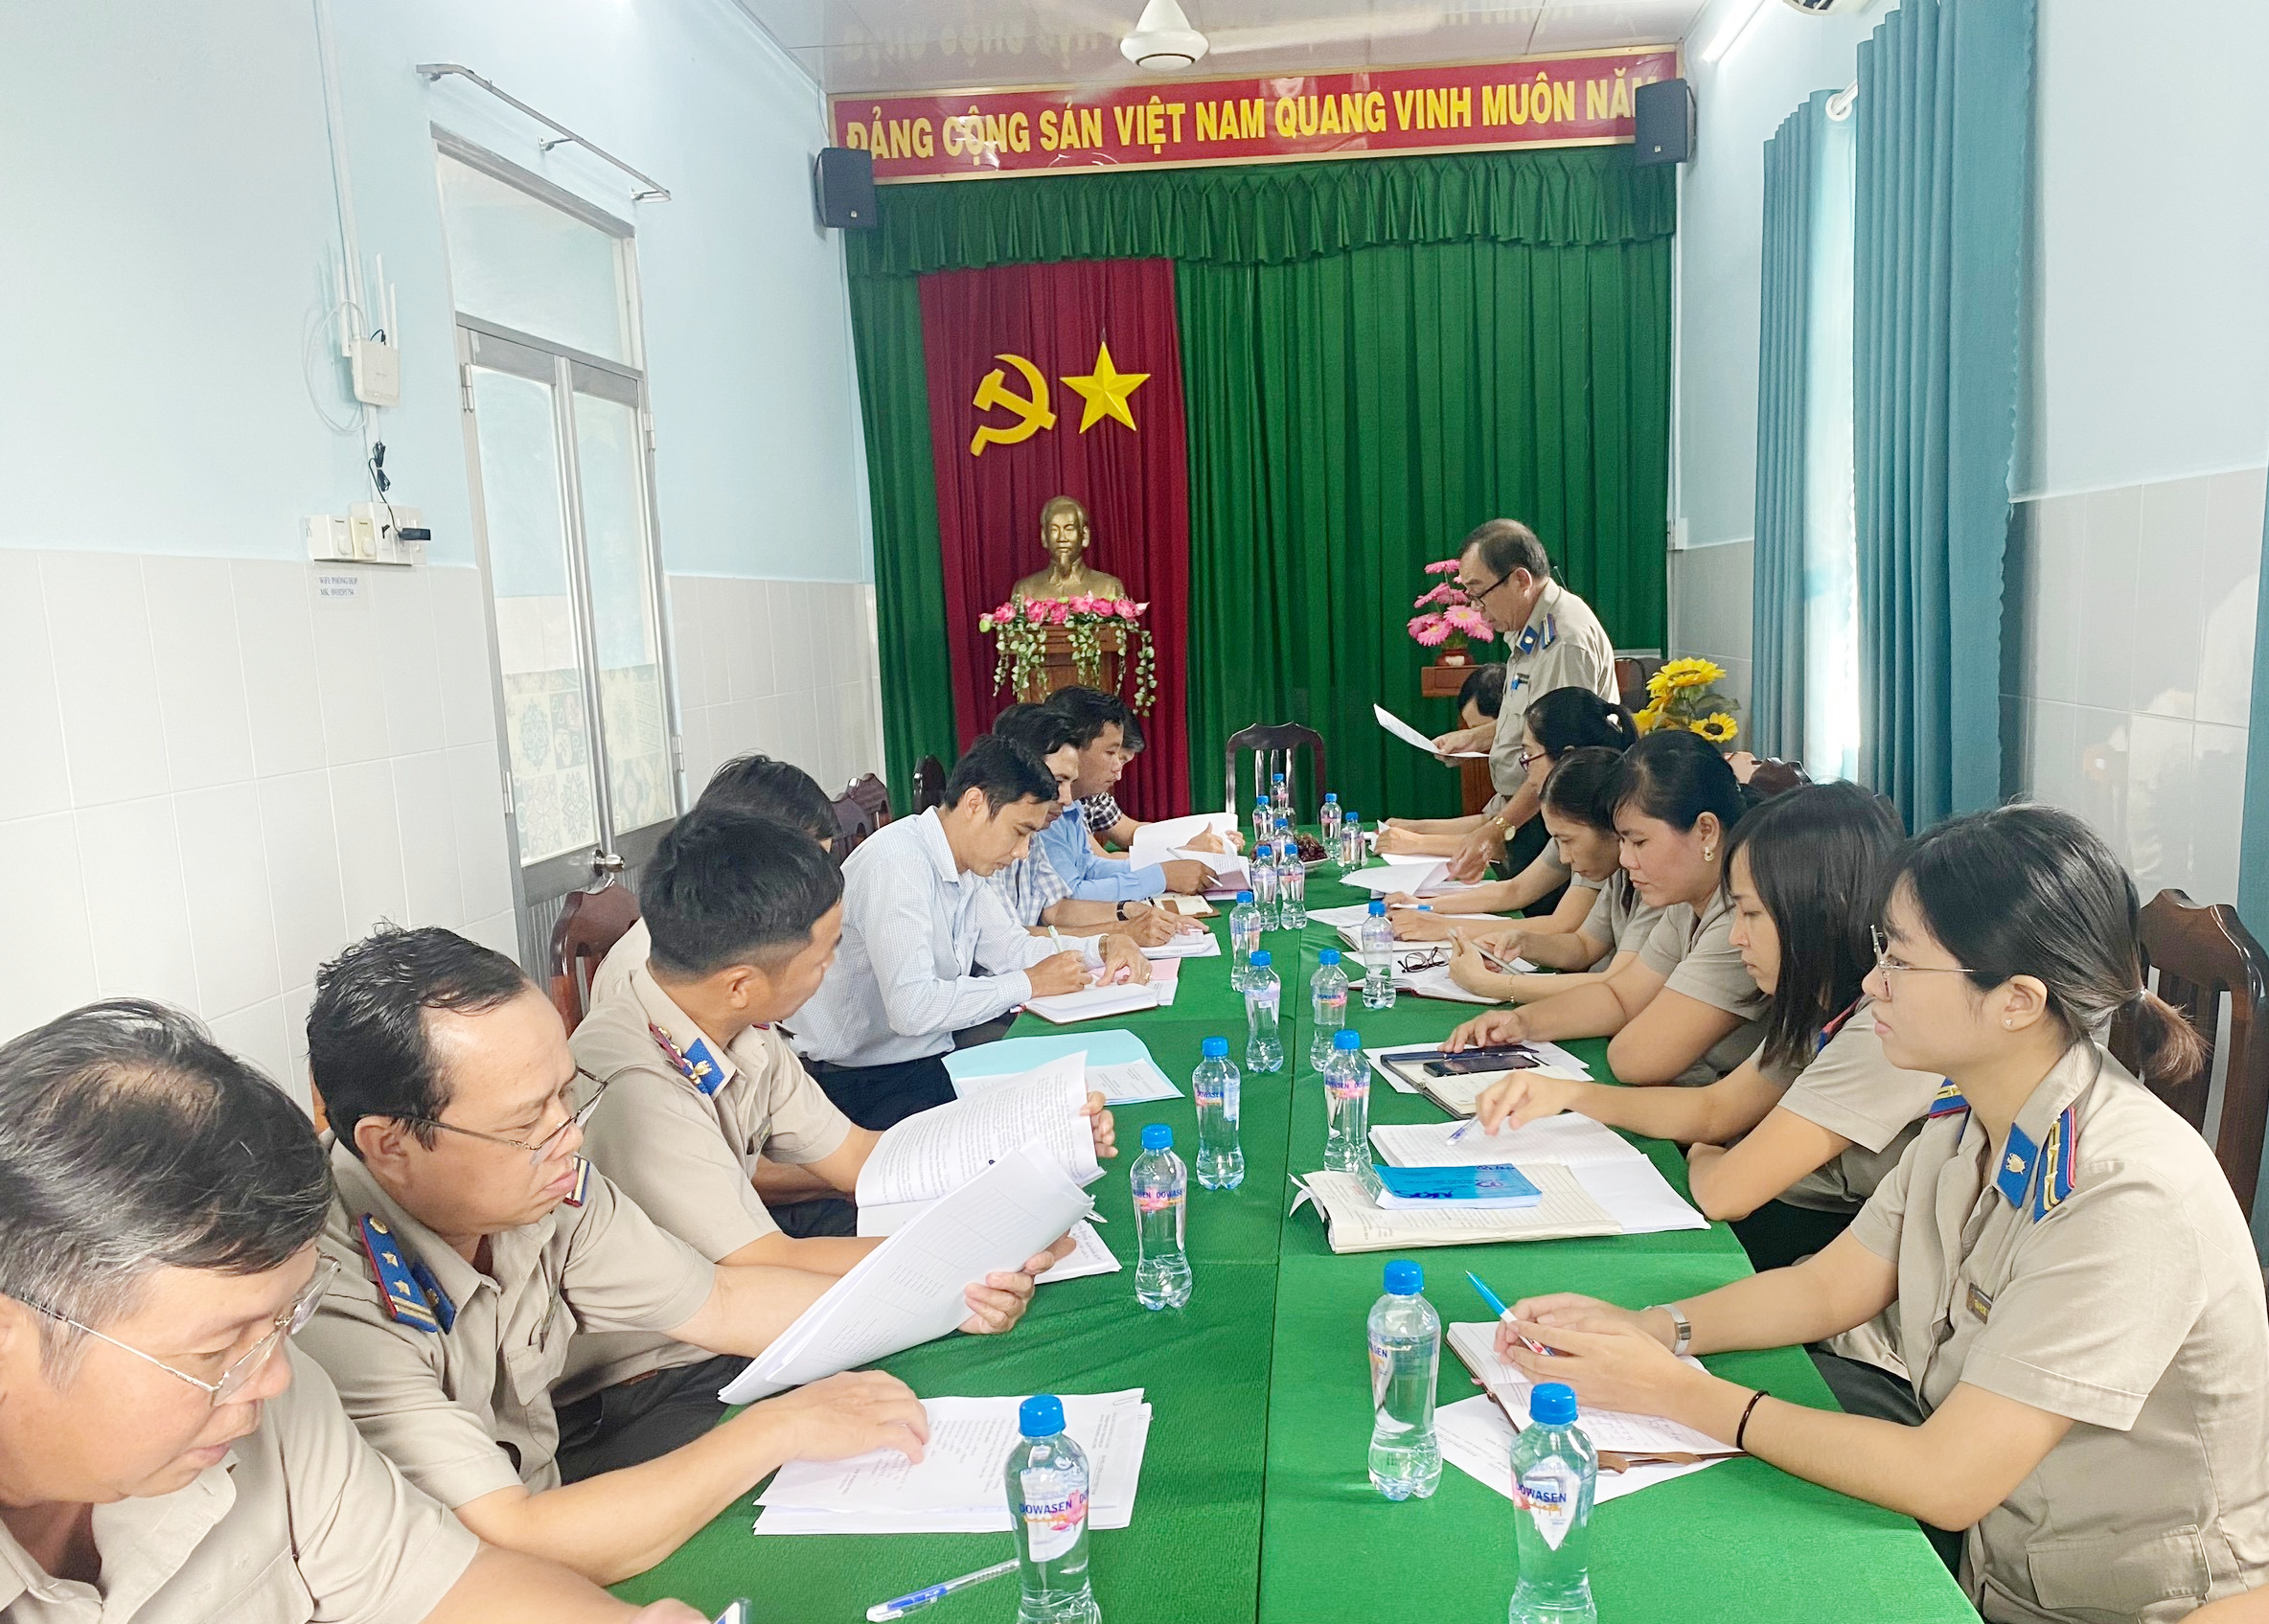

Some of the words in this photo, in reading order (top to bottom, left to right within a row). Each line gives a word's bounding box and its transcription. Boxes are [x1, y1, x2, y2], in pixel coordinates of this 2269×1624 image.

[847, 106, 934, 160] ĐẢNG
[943, 105, 1031, 166] CỘNG
[1113, 96, 1186, 153] VIỆT
[1196, 99, 1265, 142] NAM
[1275, 90, 1387, 139] QUANG
[1393, 87, 1472, 130] VINH
[1481, 72, 1576, 126] MUÔN
[1019, 1499, 1072, 1515] DOWASEN
